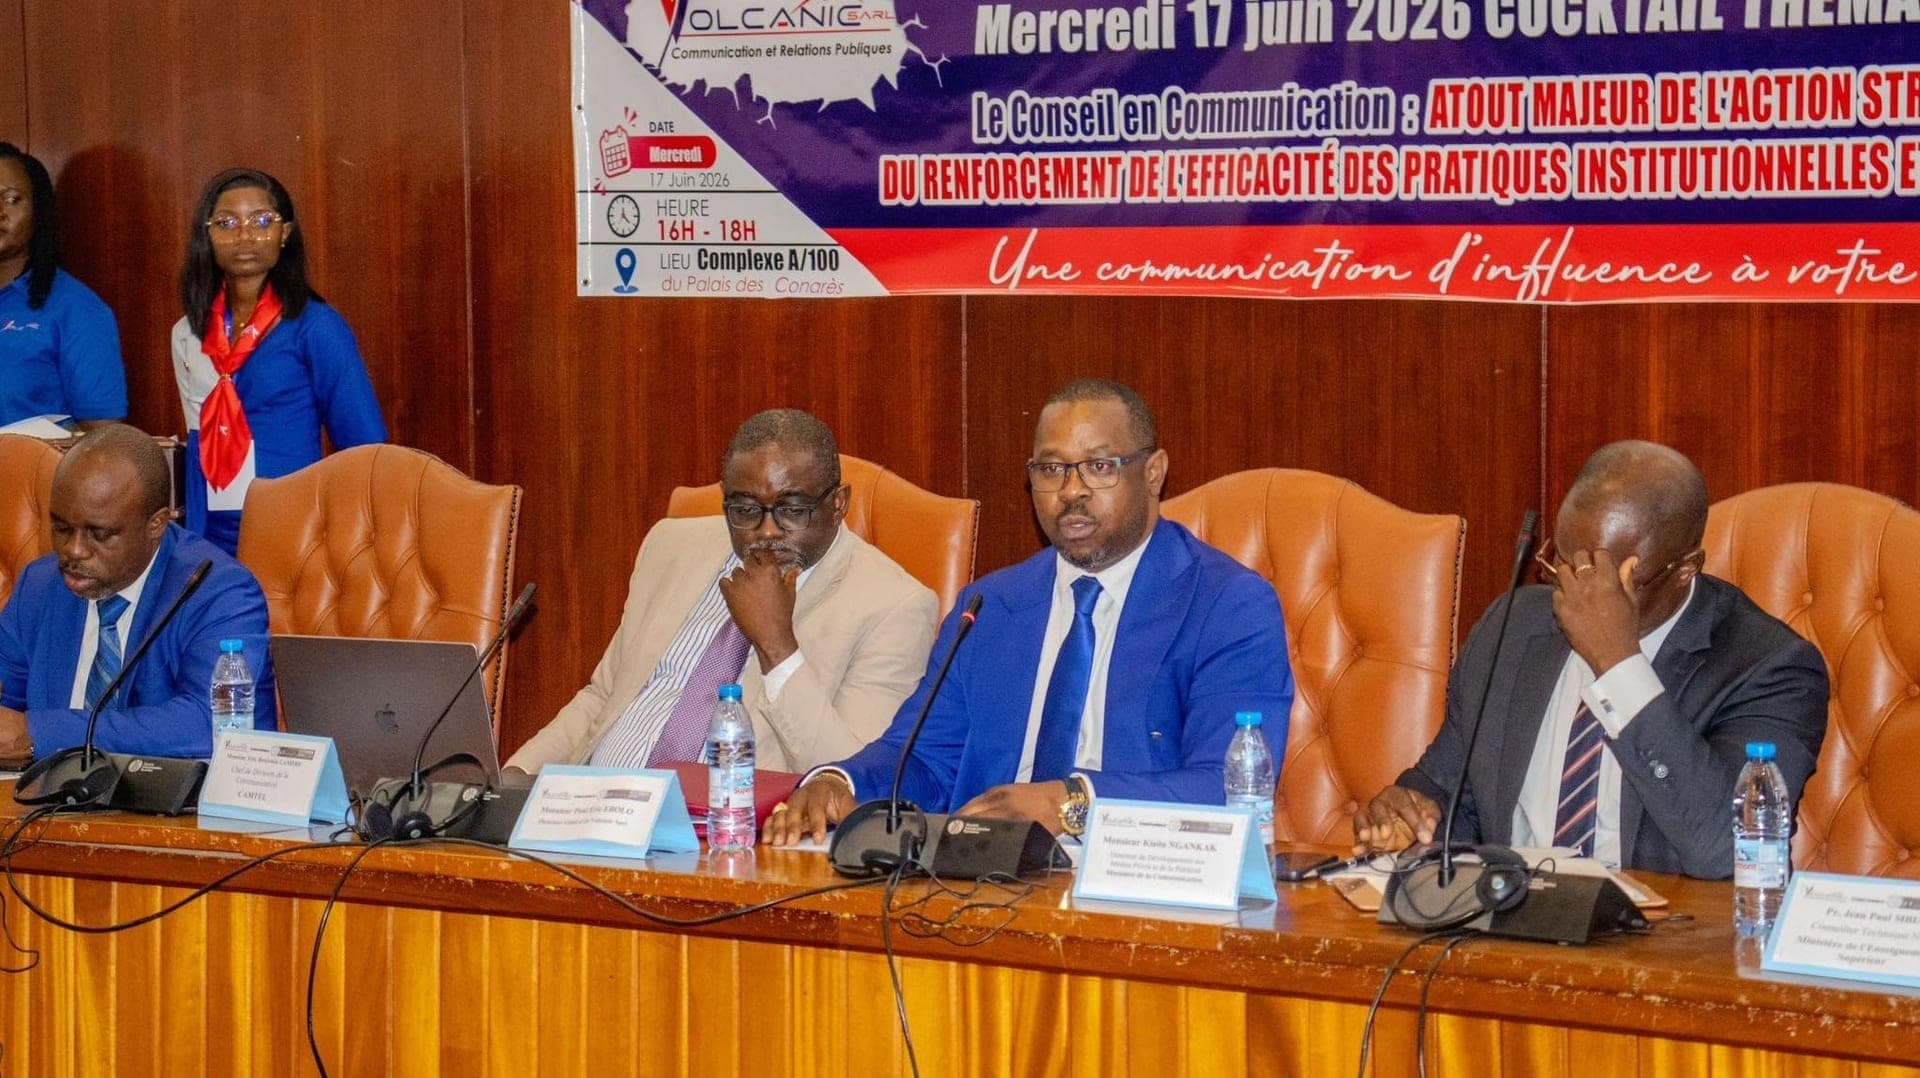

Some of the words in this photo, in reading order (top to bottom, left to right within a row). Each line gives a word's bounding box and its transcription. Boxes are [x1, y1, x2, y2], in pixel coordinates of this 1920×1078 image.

[847, 10, 896, 20] SARL
[975, 0, 1176, 55] Mercredi
[1191, 0, 1232, 48] 17
[1245, 0, 1333, 52] juin
[1346, 0, 1471, 43] 2026
[1485, 0, 1723, 39] COCKTAIL
[671, 45, 763, 60] Communication
[765, 46, 776, 57] et
[780, 44, 832, 57] Relations
[835, 42, 892, 58] Publiques
[975, 95, 1004, 141] Le
[1012, 91, 1116, 140] Conseil
[1123, 103, 1158, 138] en
[1166, 84, 1393, 138] Communication
[1428, 80, 1525, 131] ATOUT
[1531, 77, 1651, 129] MAJEUR
[1659, 76, 1697, 126] DE
[1705, 69, 1854, 125] L'ACTION
[650, 121, 674, 133] DATE
[650, 146, 702, 163] Mercredi
[650, 172, 663, 187] 17
[668, 172, 695, 187] Juin
[700, 172, 730, 188] 2026
[882, 157, 917, 202] DU
[922, 155, 1124, 202] RENFORCEMENT
[1129, 154, 1160, 200] DE
[1165, 142, 1337, 199] L'EFFICACITÉ
[1343, 150, 1396, 198] DES
[1402, 146, 1570, 202] PRATIQUES
[1576, 140, 1891, 196] INSTITUTIONNELLES
[1900, 140, 1920, 191] E
[657, 199, 709, 217] HEURE
[658, 220, 694, 240] 16H
[720, 220, 756, 241] 18H
[660, 253, 690, 270] LIEU
[698, 248, 784, 272] Complexe
[788, 248, 839, 271] A/100
[989, 229, 1080, 291] Une
[1097, 240, 1410, 289] communication
[1731, 255, 1768, 284] à
[1788, 239, 1917, 295] votre
[662, 276, 681, 291] du
[687, 276, 731, 292] Palais
[736, 276, 763, 292] des
